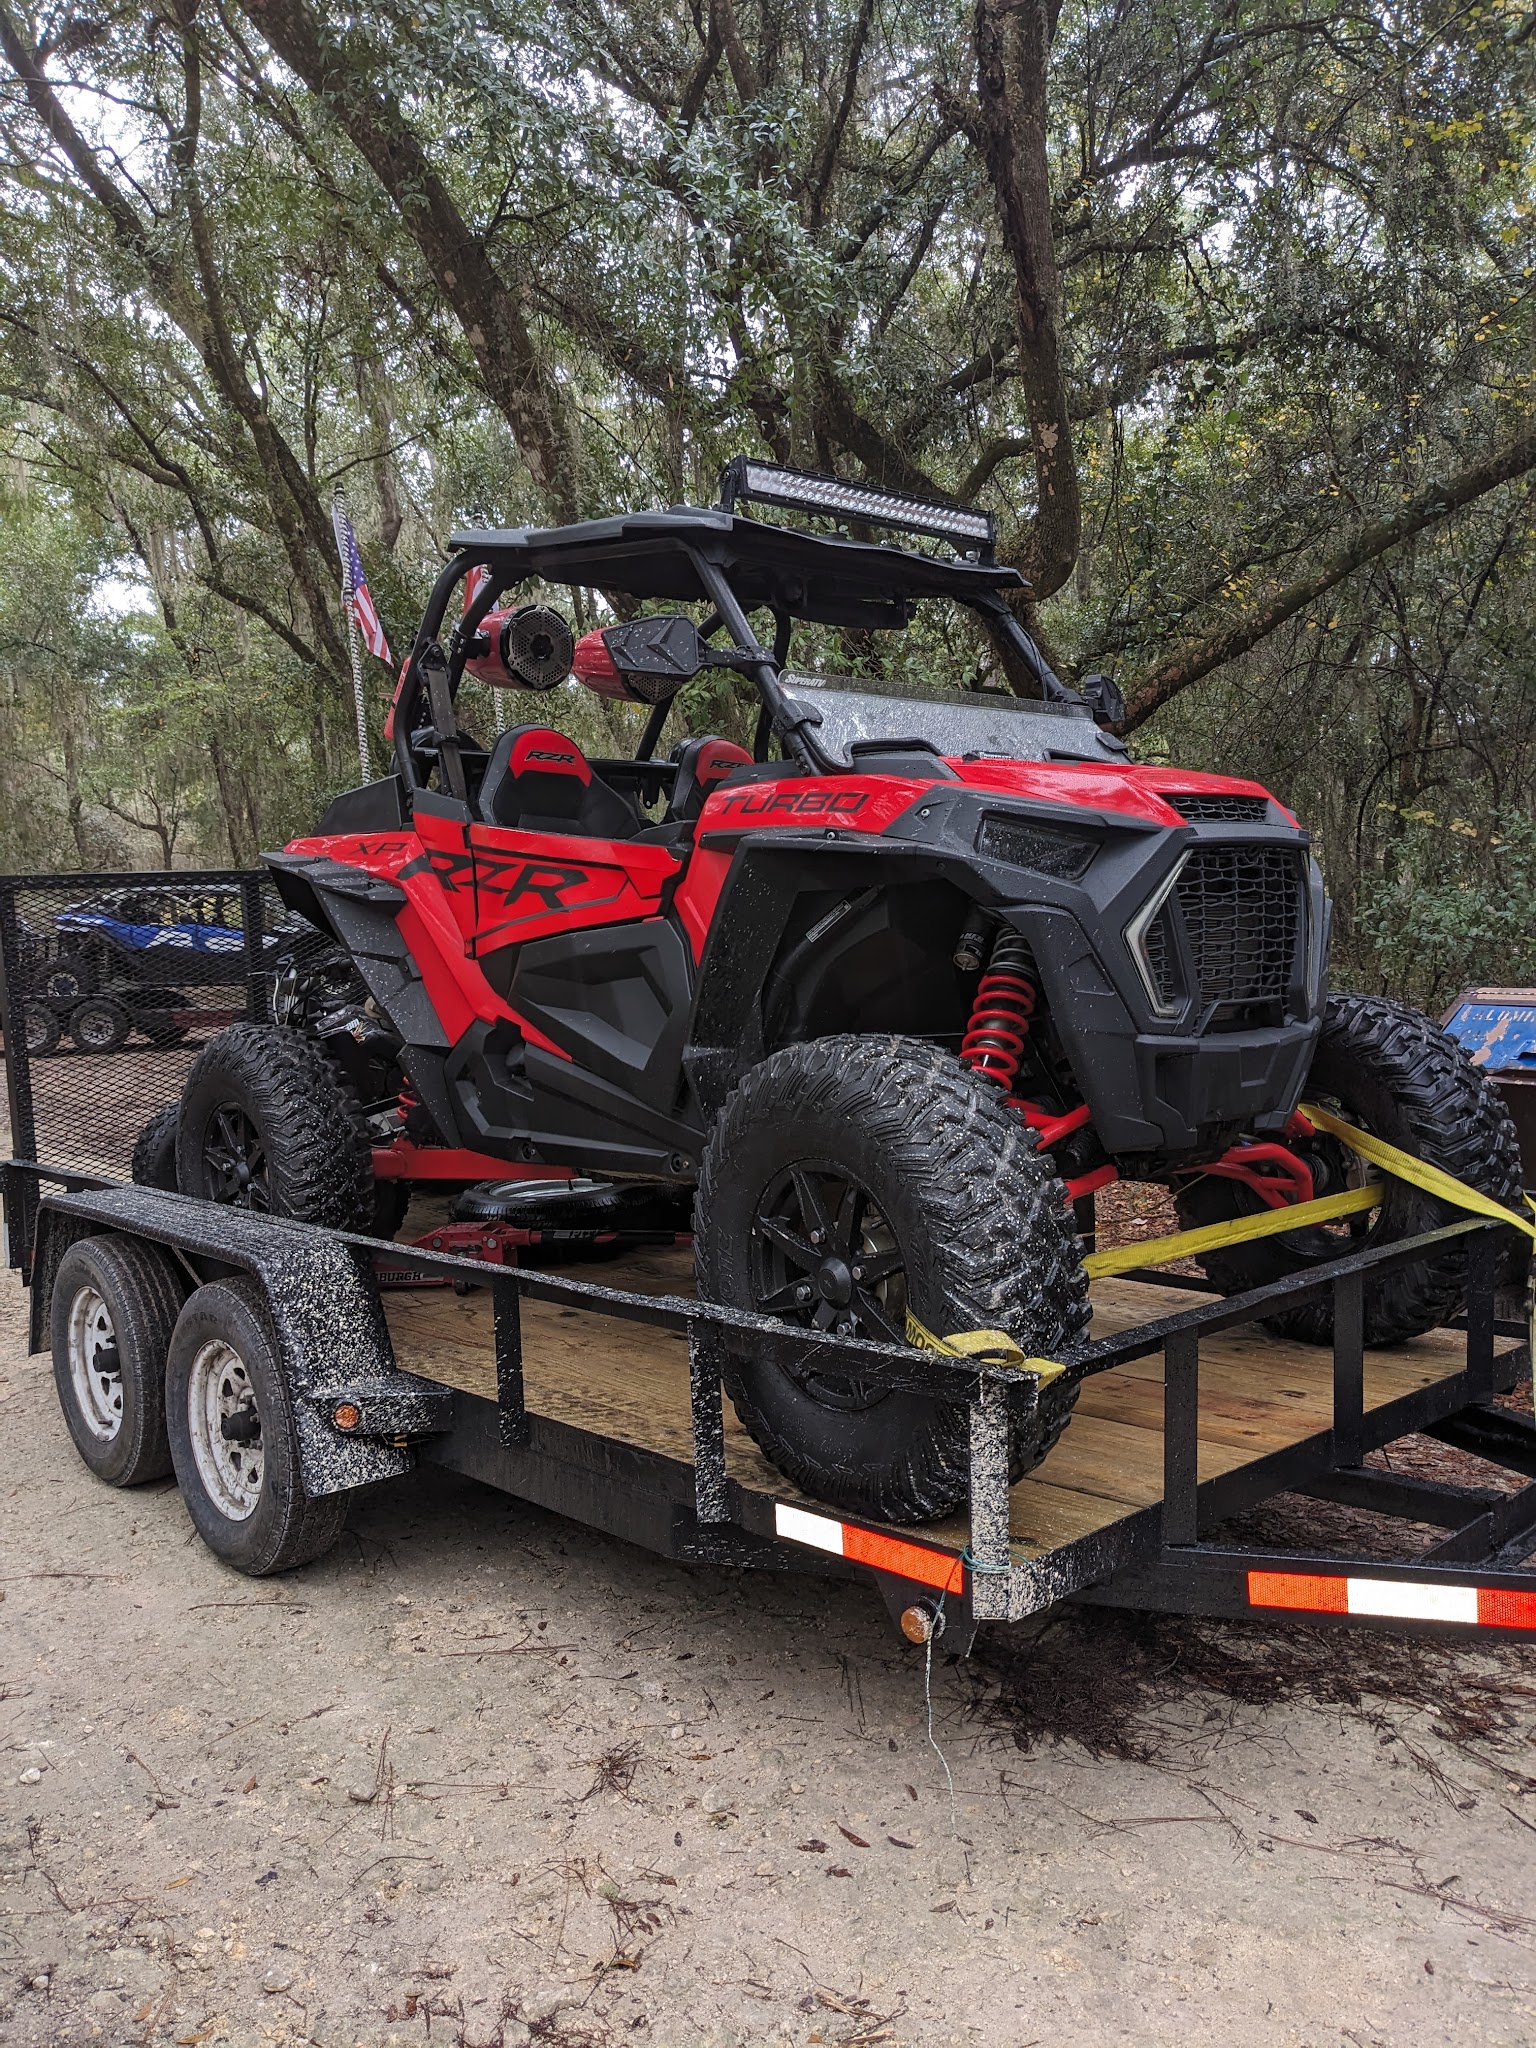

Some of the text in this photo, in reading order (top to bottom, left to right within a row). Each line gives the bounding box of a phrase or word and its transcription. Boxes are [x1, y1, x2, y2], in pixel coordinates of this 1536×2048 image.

[525, 750, 575, 764] RZR
[721, 792, 870, 815] TURBO
[352, 842, 407, 856] XP
[395, 847, 589, 913] RZR
